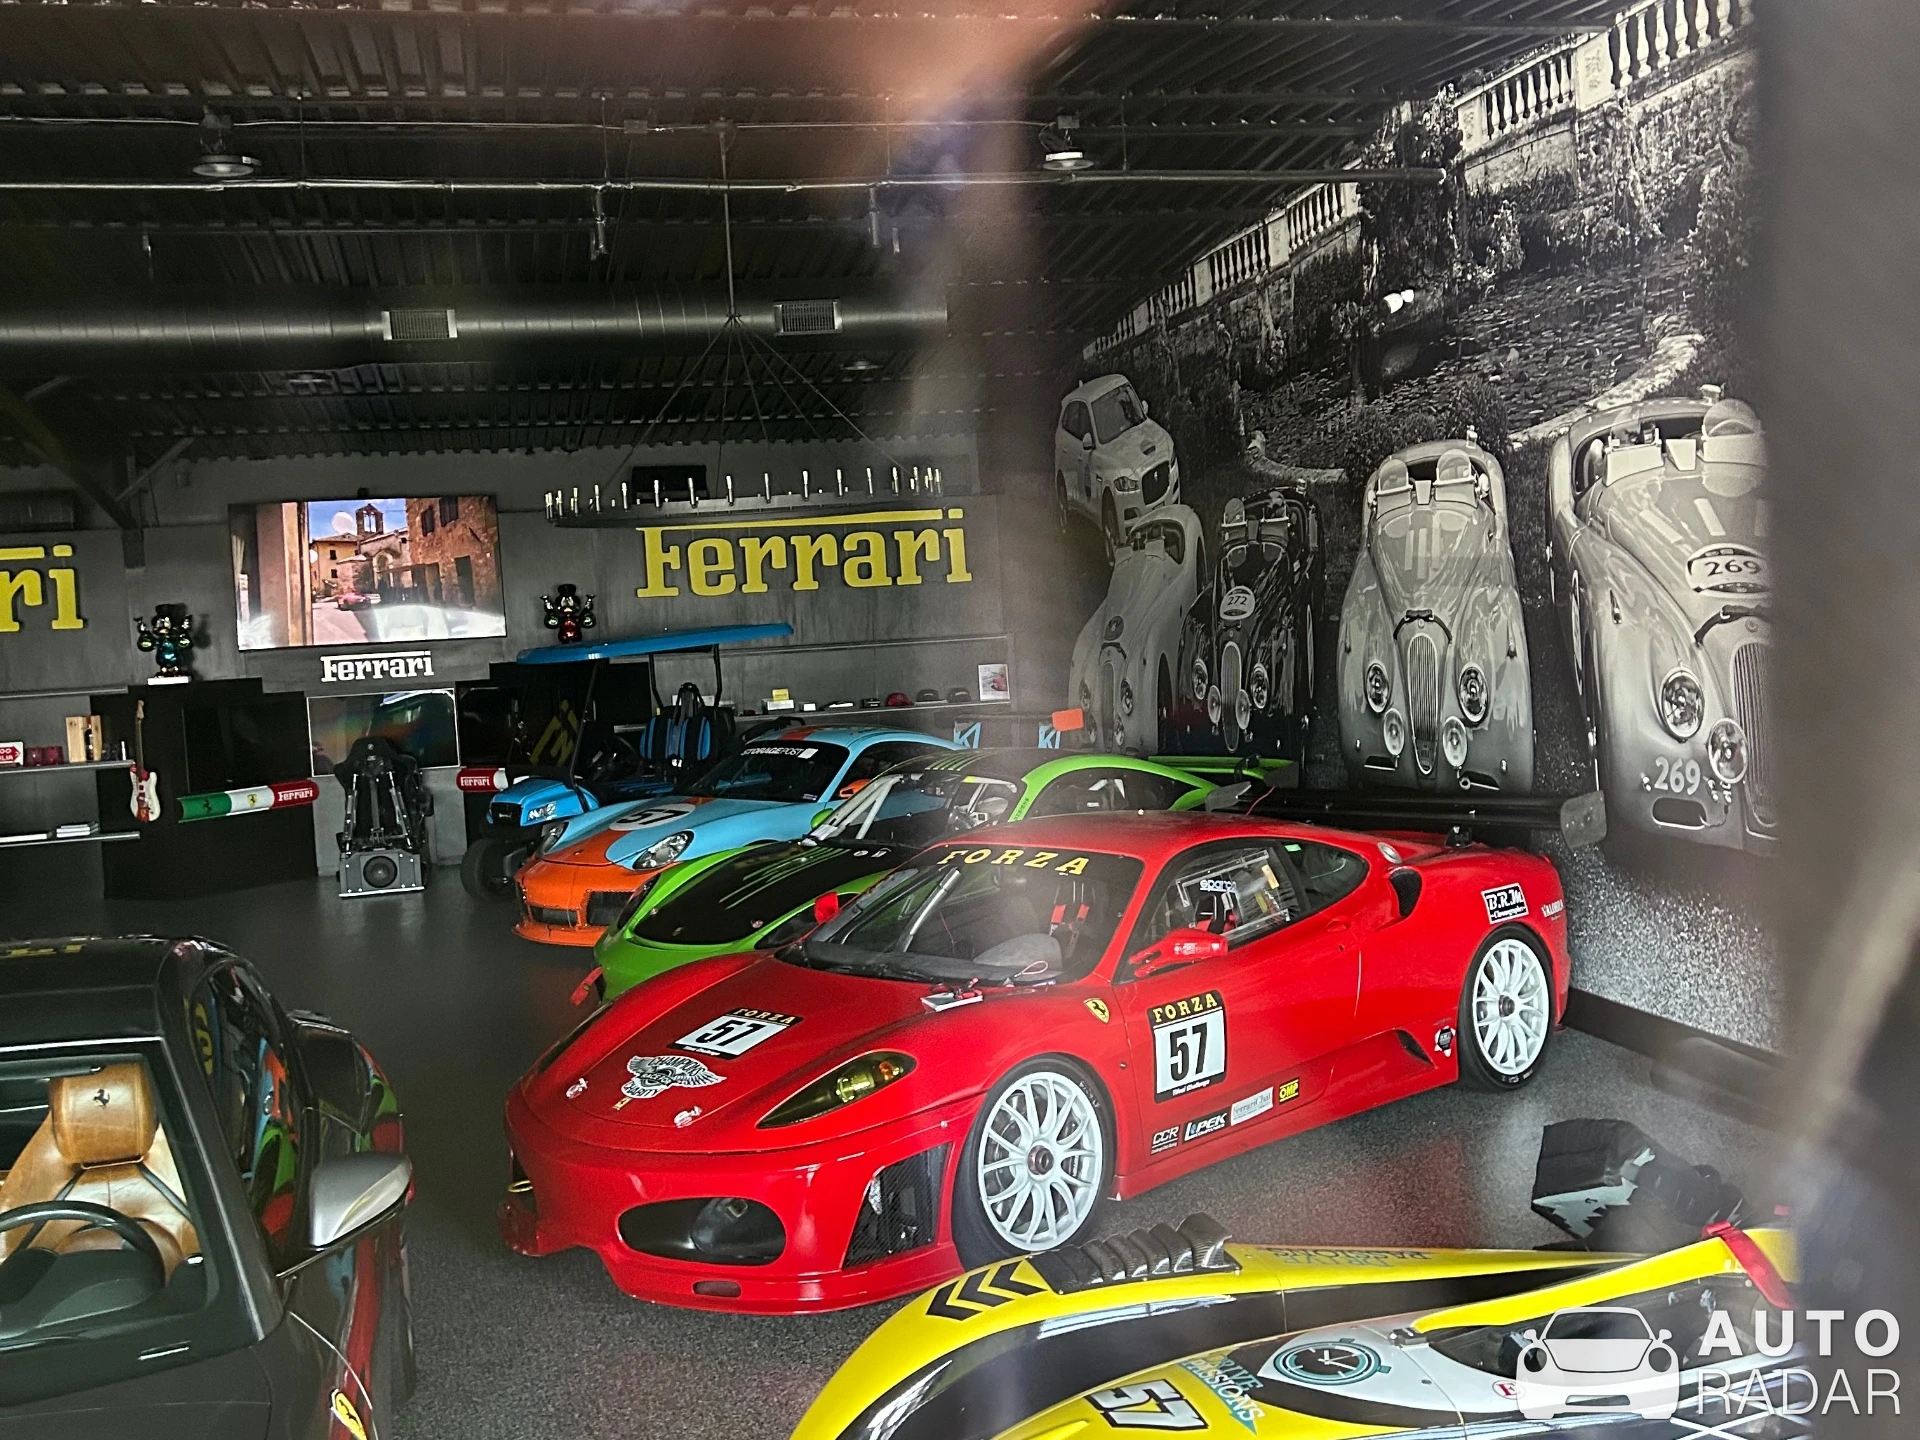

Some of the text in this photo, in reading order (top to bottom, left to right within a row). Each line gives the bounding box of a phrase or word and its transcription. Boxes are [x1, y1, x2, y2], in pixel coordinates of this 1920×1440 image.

[636, 508, 973, 597] Ferrari
[1704, 560, 1761, 577] 269
[1227, 595, 1248, 605] 272
[320, 650, 435, 682] Ferrari
[460, 776, 490, 787] Ferrari
[1654, 755, 1701, 796] 269
[277, 788, 313, 802] Ferrari
[616, 808, 690, 826] 57
[937, 848, 1090, 875] FORZA
[732, 1008, 796, 1024] FORZA
[1153, 992, 1218, 1023] FORZA
[695, 1019, 767, 1047] 57
[1169, 1022, 1208, 1081] 57
[1279, 1081, 1299, 1099] OMP
[1153, 1126, 1180, 1145] CCR
[1087, 1379, 1209, 1431] 57
